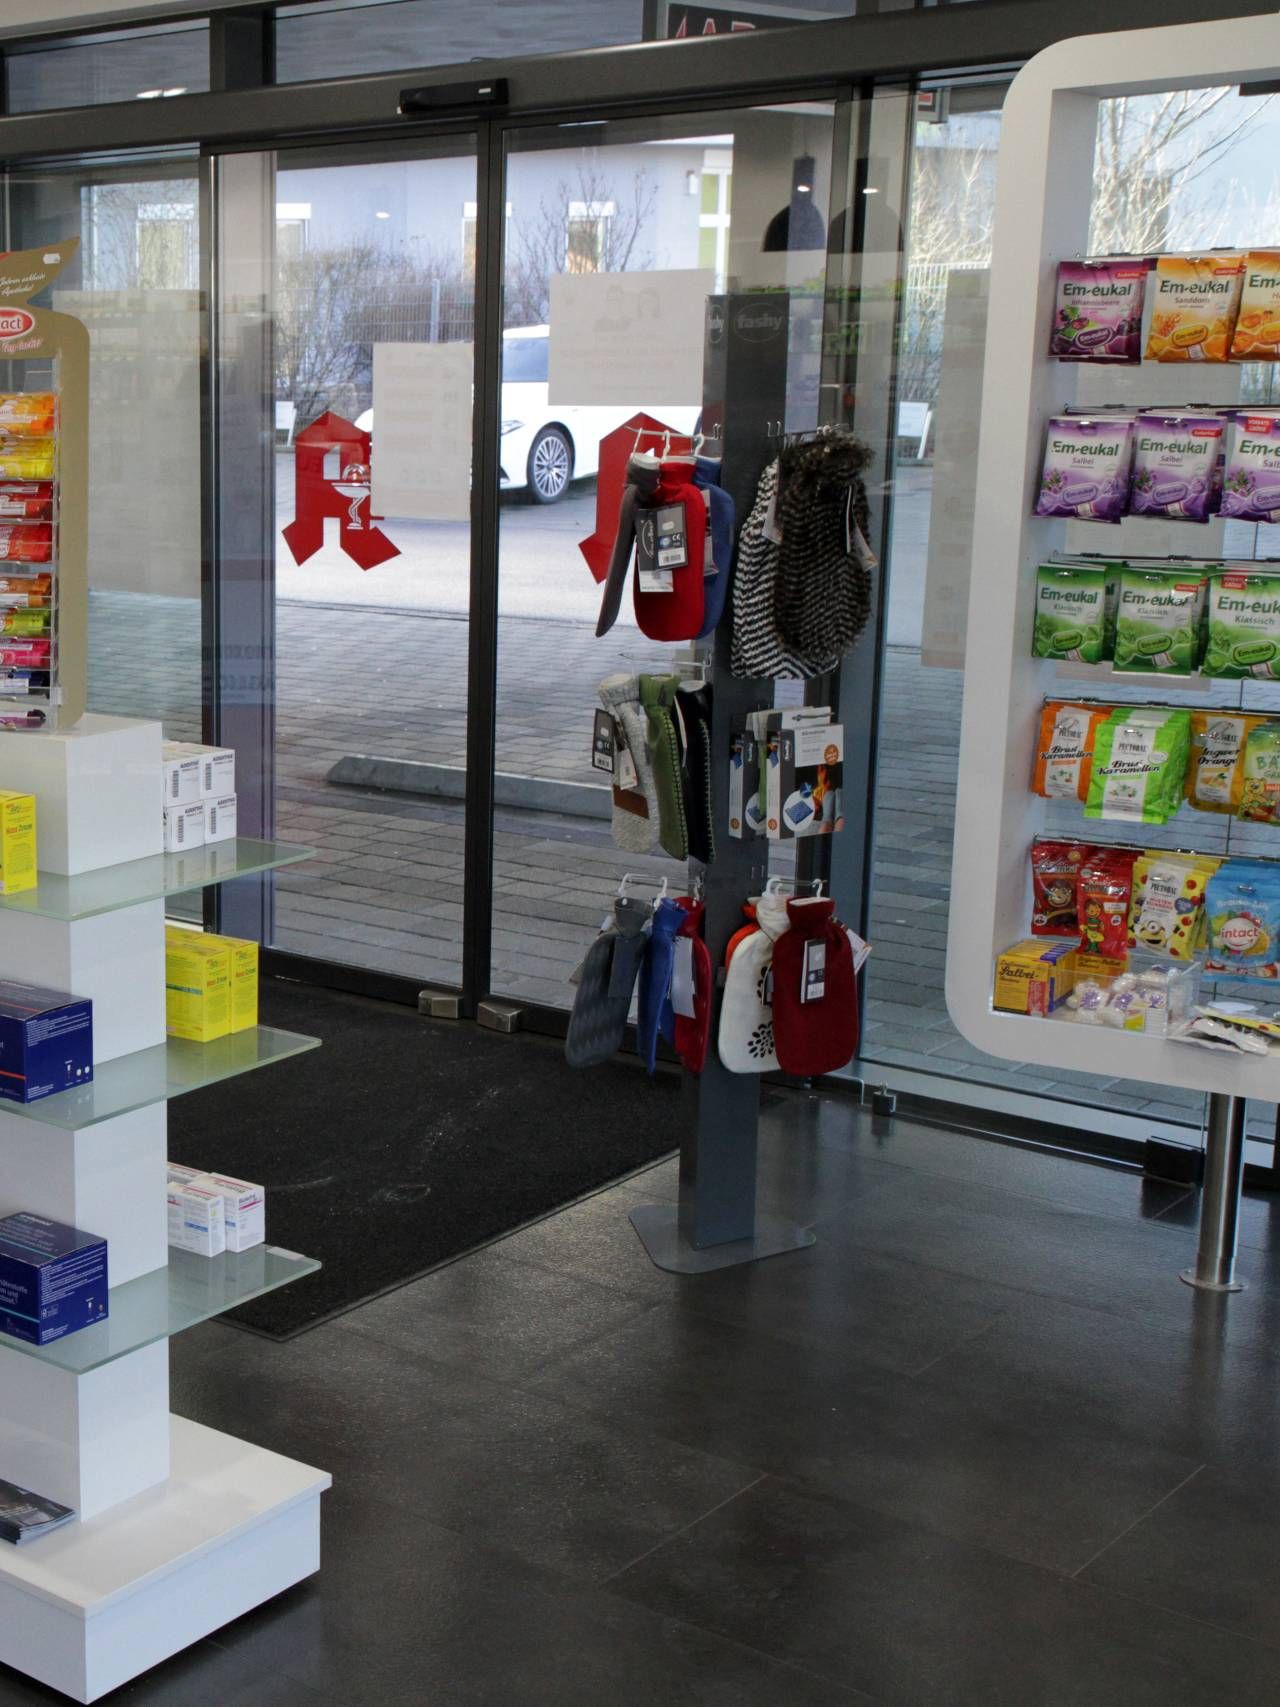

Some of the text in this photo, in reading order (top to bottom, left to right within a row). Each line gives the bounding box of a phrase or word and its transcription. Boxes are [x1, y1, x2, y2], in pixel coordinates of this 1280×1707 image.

[1063, 283, 1132, 297] Em-eukal
[1159, 280, 1230, 294] Em-eukal
[738, 314, 784, 329] fashy
[1052, 441, 1119, 457] Em-eukal
[1140, 438, 1208, 455] Em-eukal
[1040, 587, 1098, 604] Em-eukal
[1234, 615, 1275, 626] Klassisch
[1221, 926, 1259, 938] intact
